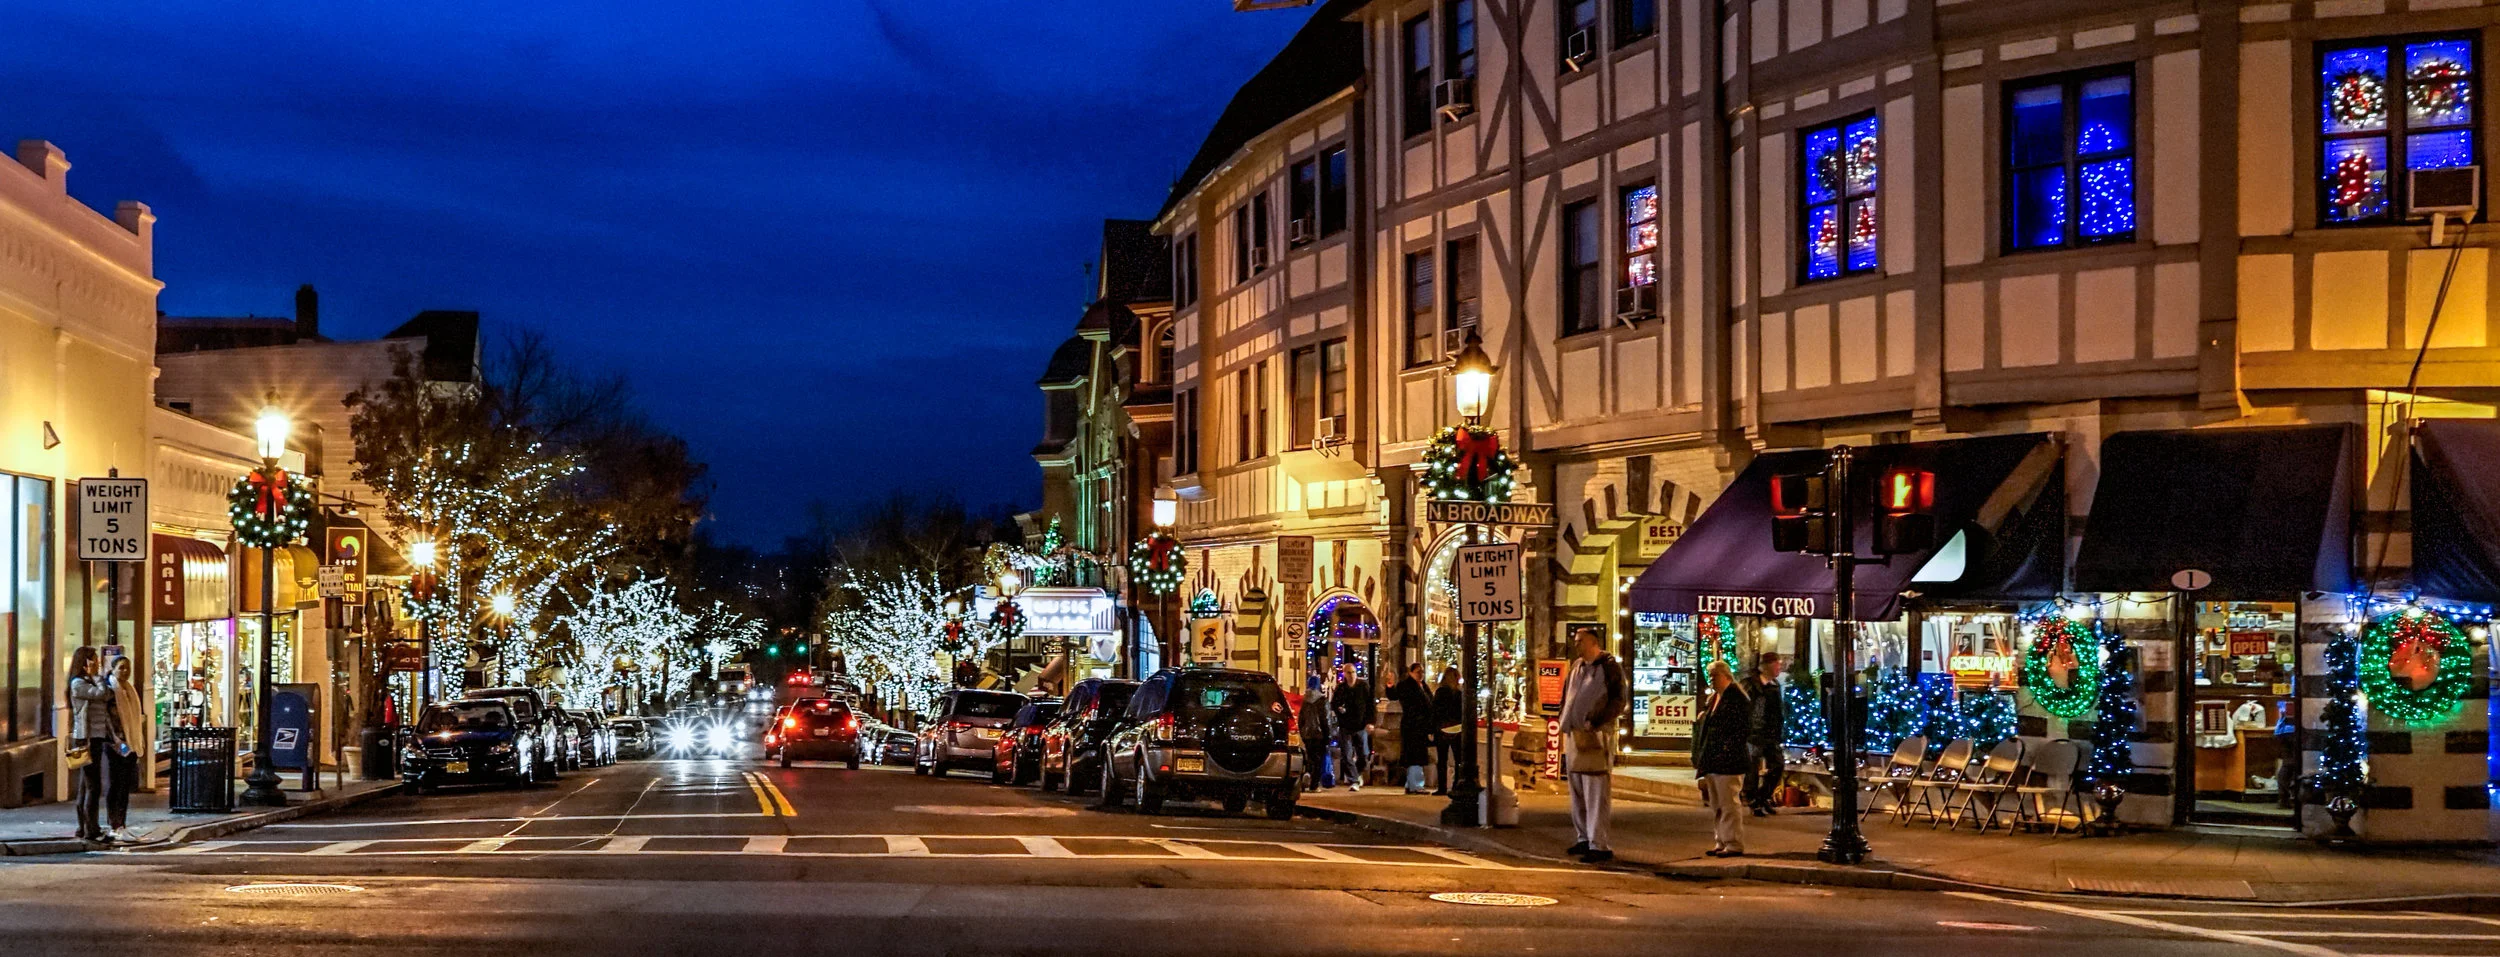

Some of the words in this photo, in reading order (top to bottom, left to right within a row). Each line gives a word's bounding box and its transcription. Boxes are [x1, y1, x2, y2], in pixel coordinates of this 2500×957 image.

[86, 485, 141, 497] WEIGHT
[93, 501, 132, 513] LIMIT
[1429, 503, 1441, 519] N
[1448, 504, 1549, 523] BROADWAY
[106, 518, 119, 533] 5
[1649, 525, 1682, 537] BEST
[88, 538, 138, 553] TONS
[1464, 550, 1514, 563] WEIGHT
[161, 553, 175, 606] NAIL
[1470, 566, 1507, 578] LIMIT
[2188, 571, 2194, 588] 1
[1484, 582, 1496, 596] 5
[1468, 600, 1514, 616] TONS
[1698, 596, 1766, 614] LEFTERIS
[1772, 597, 1815, 616] GYRO
[2233, 642, 2265, 654] OPEN
[1950, 656, 2015, 671] RESTAURANT
[1656, 706, 1688, 717] BEST
[1546, 721, 1560, 777] OPEN
